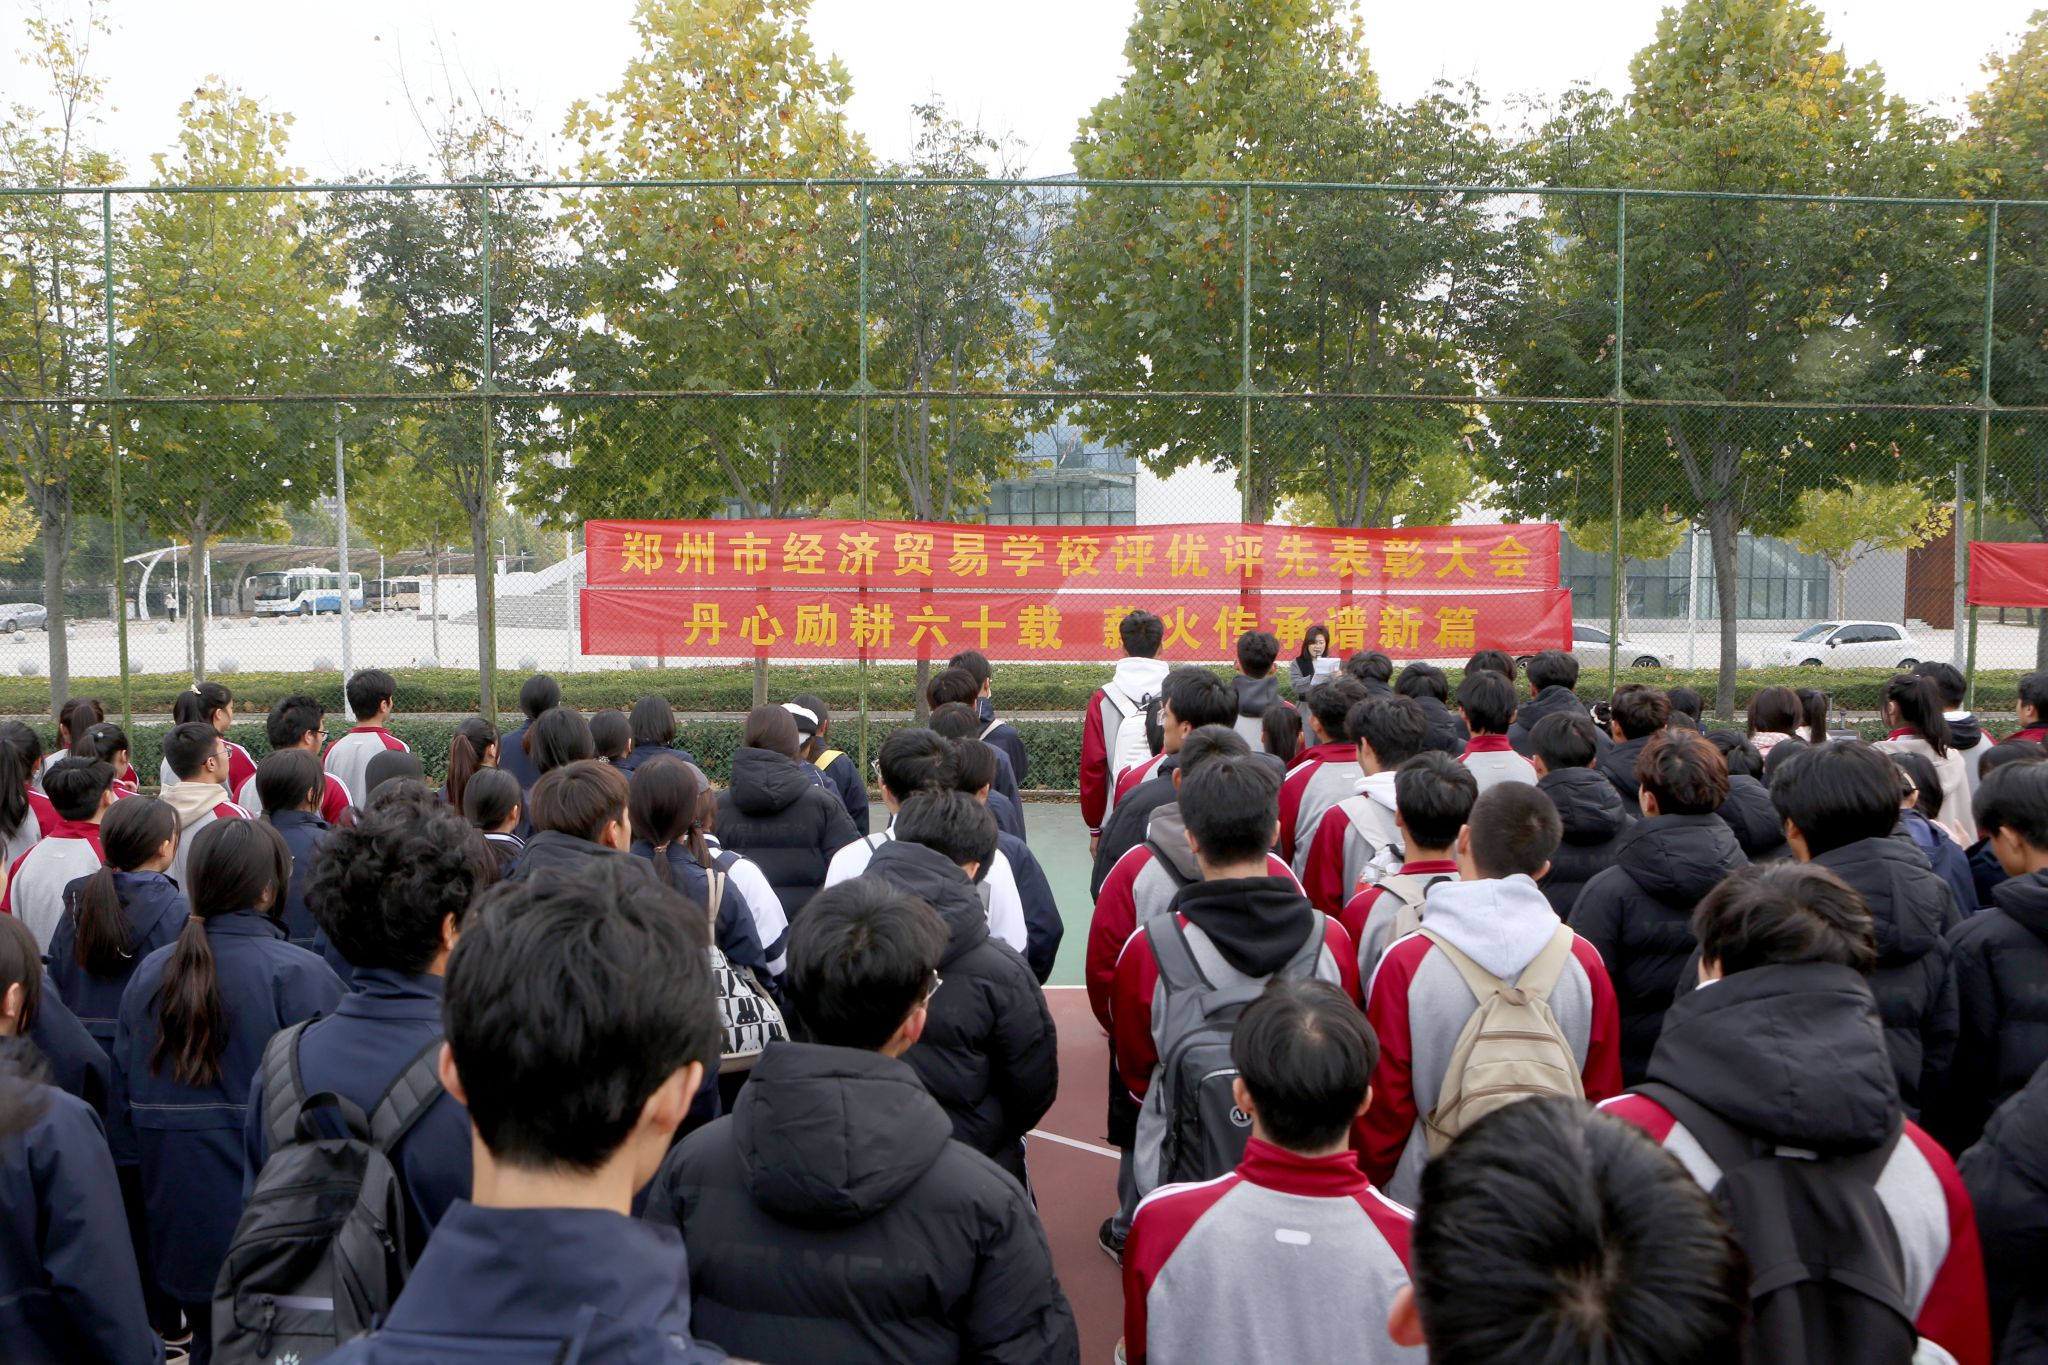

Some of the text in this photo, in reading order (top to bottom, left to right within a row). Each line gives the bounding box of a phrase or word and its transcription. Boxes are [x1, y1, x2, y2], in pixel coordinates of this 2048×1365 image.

[621, 531, 1531, 578] 郑州市经济贸易学校评优评先表彰大会
[683, 603, 1063, 650] 丹心励耕六十载
